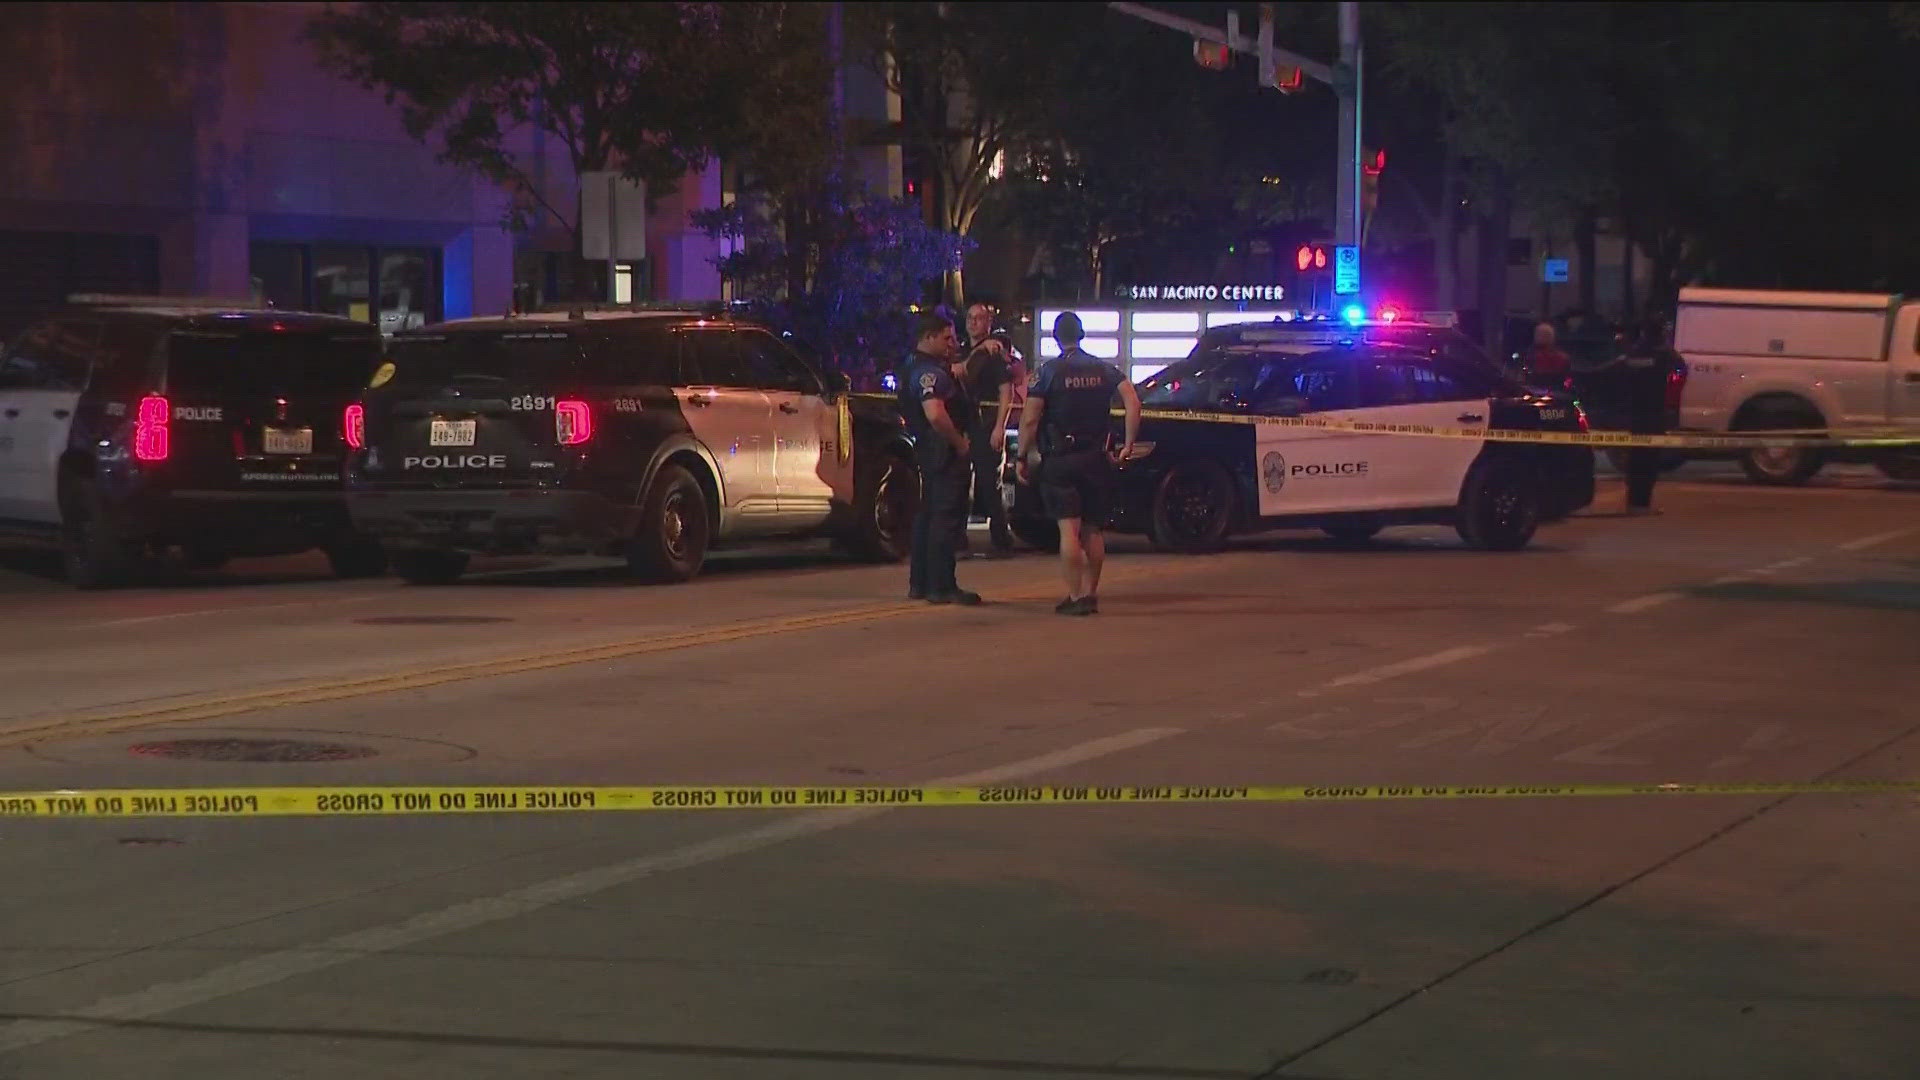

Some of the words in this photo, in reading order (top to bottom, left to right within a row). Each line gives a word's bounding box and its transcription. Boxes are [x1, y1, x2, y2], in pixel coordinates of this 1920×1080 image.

[1132, 285, 1158, 300] SAN
[1163, 285, 1218, 300] JACINTO
[1222, 285, 1284, 300] CENTER
[1065, 376, 1103, 388] POLICE
[511, 396, 556, 411] 2691
[615, 398, 644, 412] 2691
[175, 406, 223, 421] POLICE
[404, 454, 507, 470] POLICE
[1291, 461, 1369, 476] POLICE
